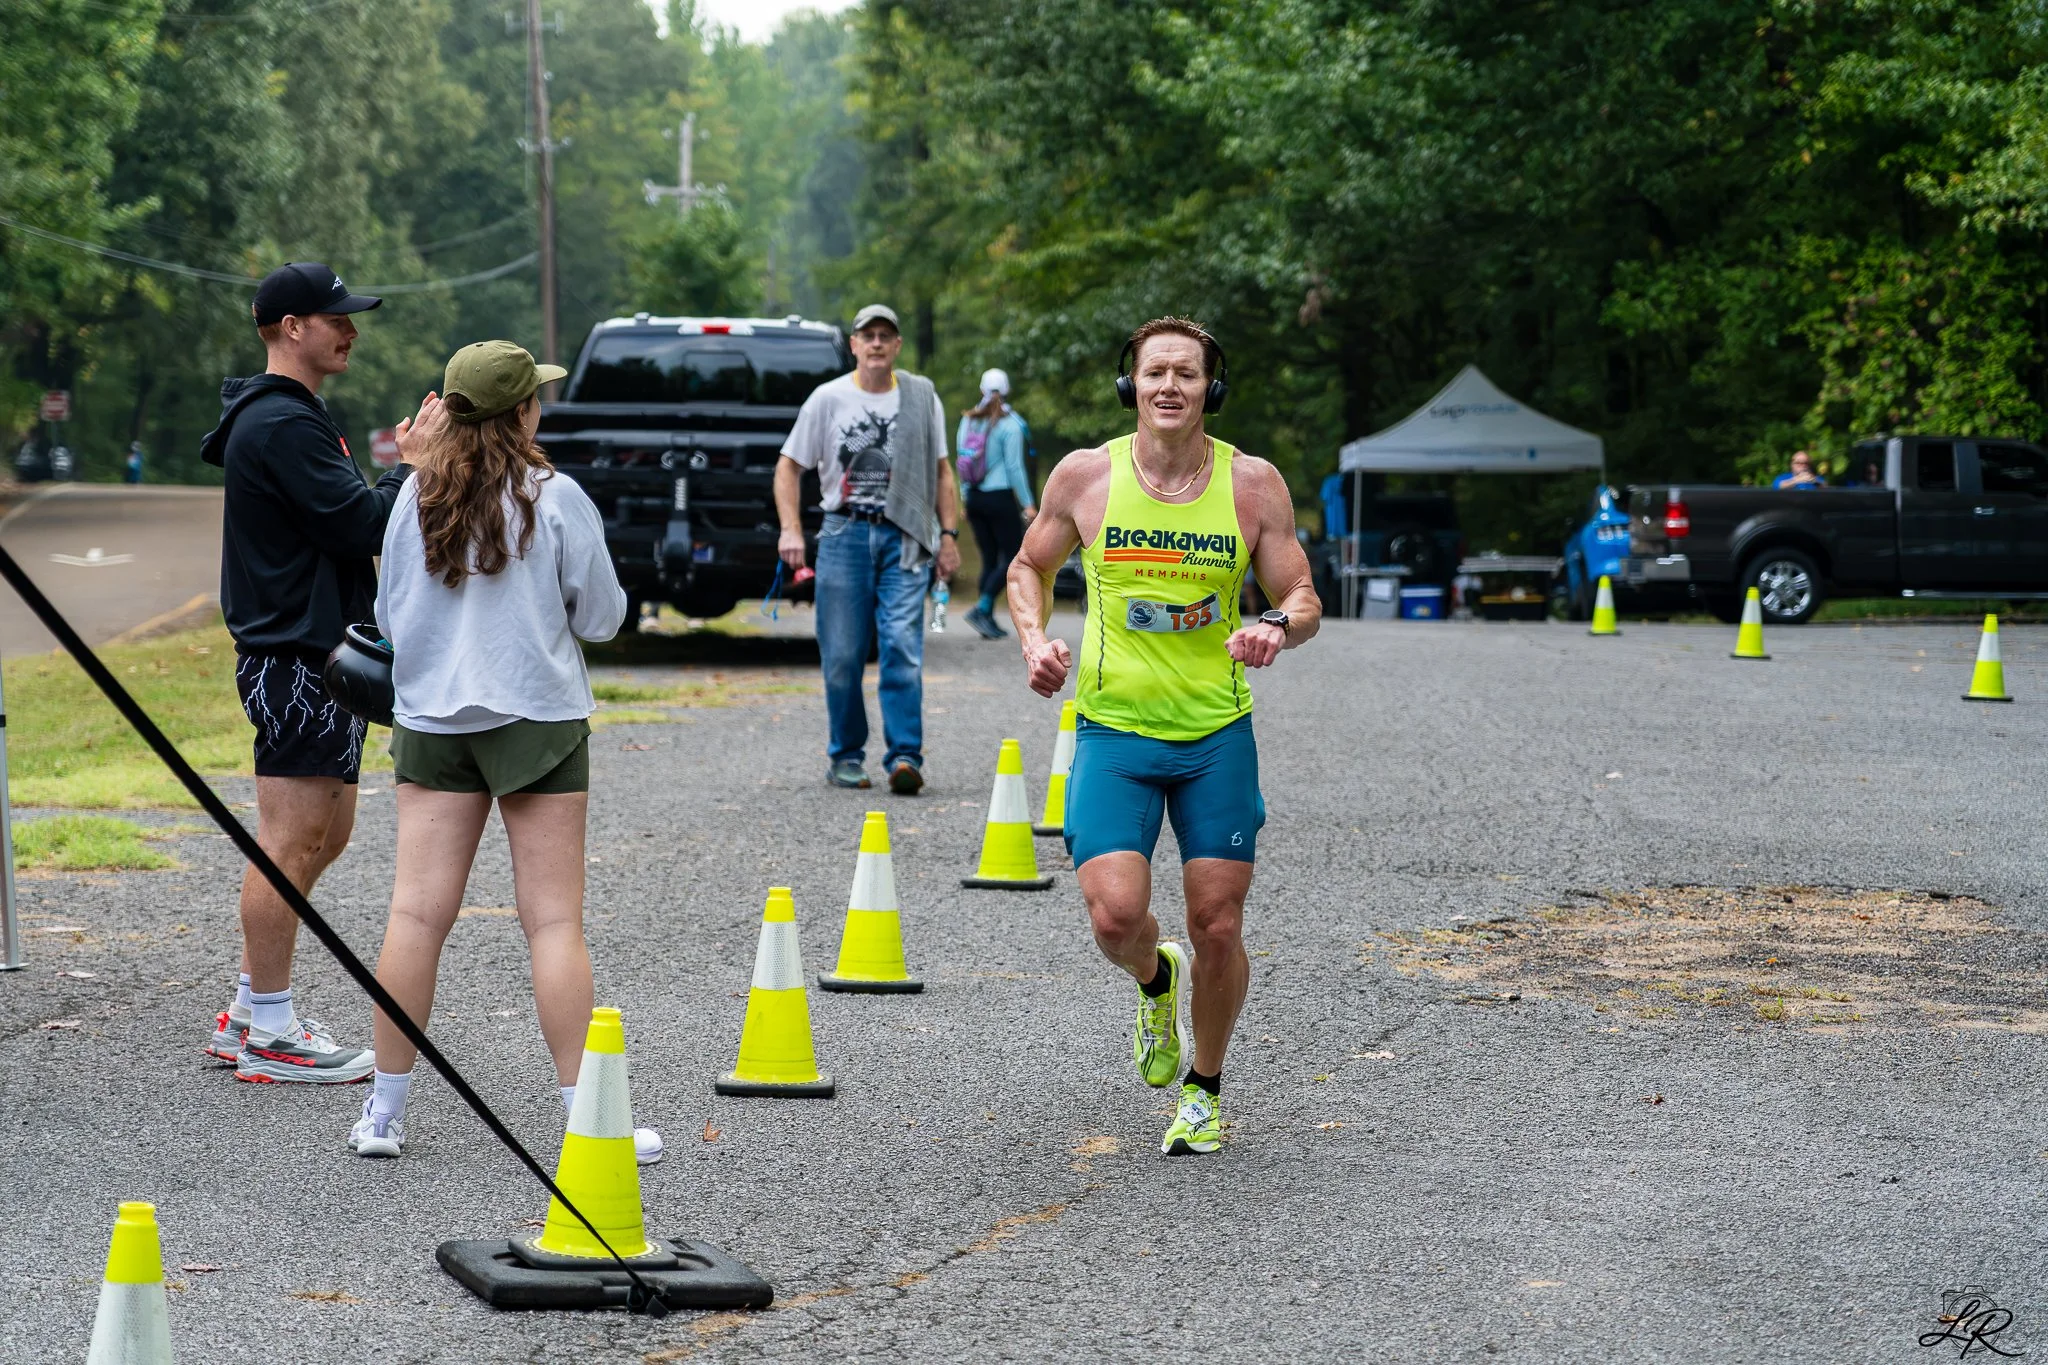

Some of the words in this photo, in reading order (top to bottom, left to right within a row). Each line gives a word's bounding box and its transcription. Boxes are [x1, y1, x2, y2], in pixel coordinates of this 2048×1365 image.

[1105, 526, 1237, 560] Breakaway
[1182, 552, 1237, 573] Running
[1135, 568, 1207, 581] MEMPHIS
[1171, 605, 1213, 631] 195
